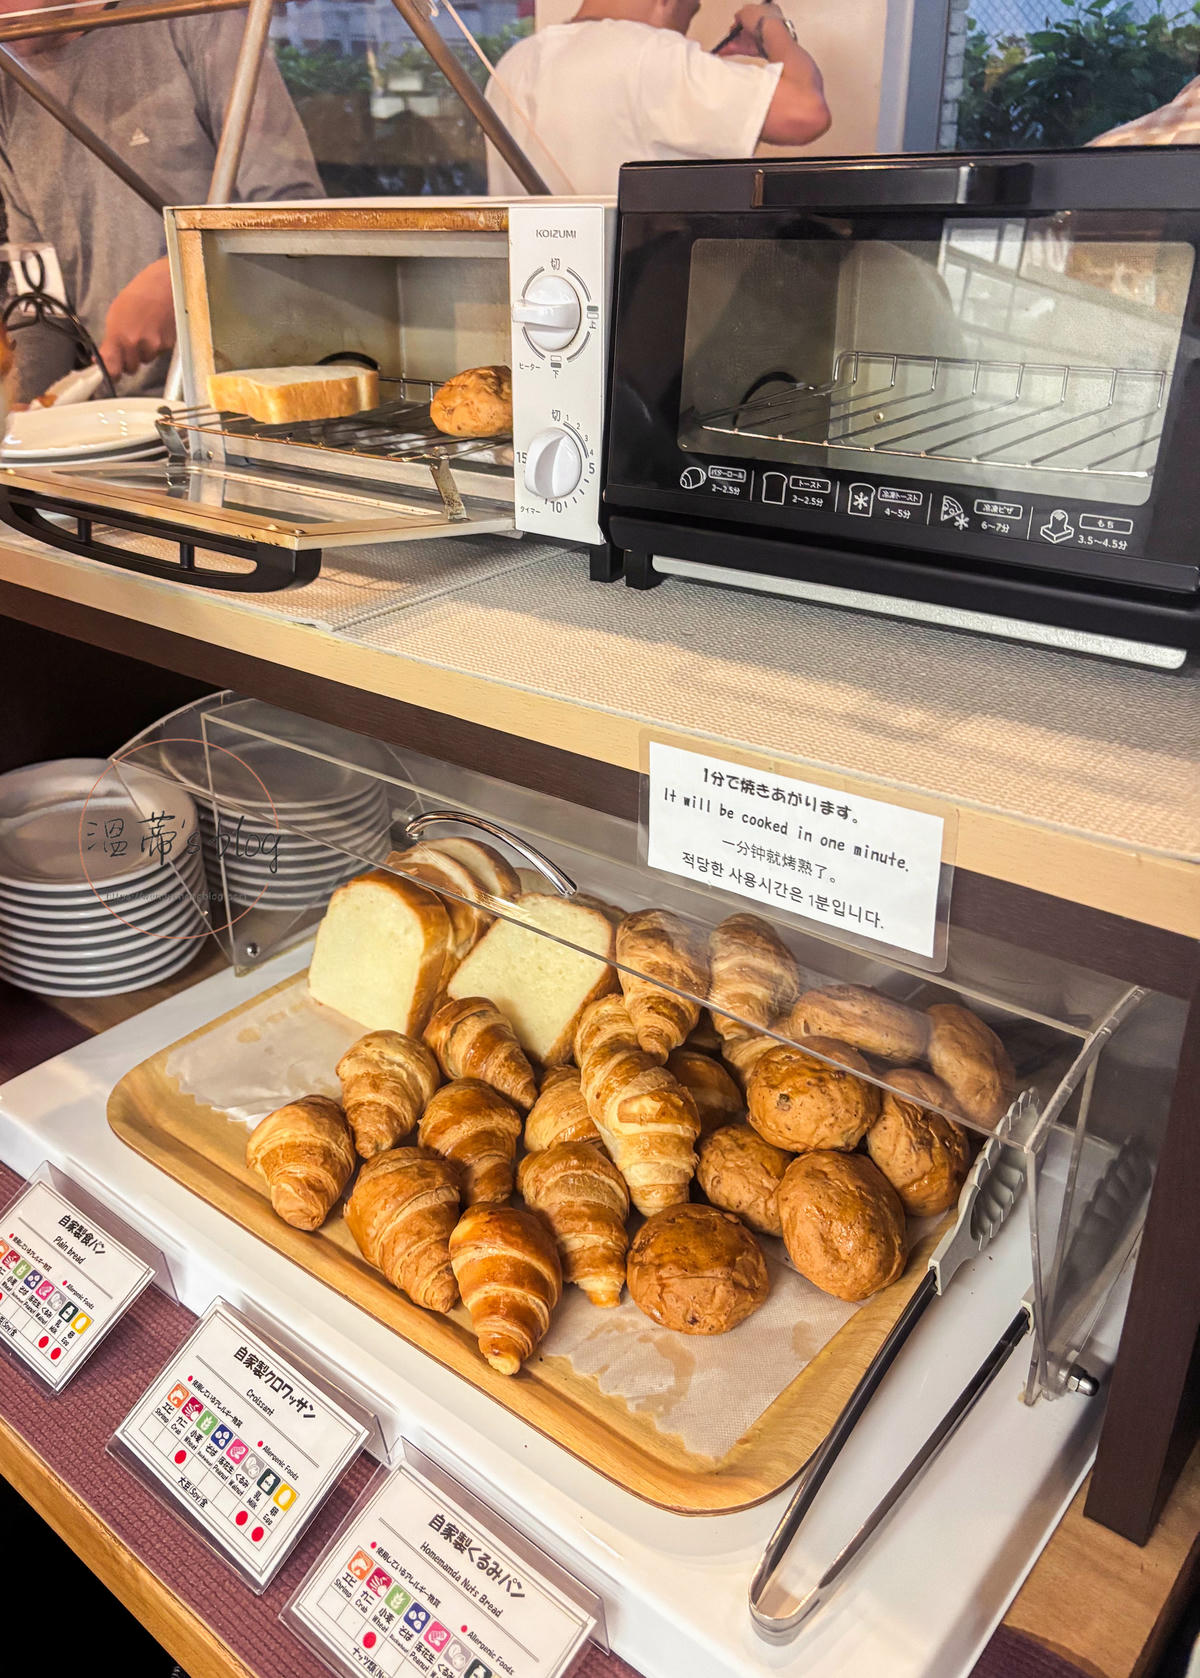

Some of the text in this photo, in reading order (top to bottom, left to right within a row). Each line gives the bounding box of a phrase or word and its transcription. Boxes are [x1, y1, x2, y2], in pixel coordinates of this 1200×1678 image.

[536, 229, 577, 240] KOIZUMI
[551, 258, 560, 270] 切
[519, 362, 541, 371] ヒーター
[552, 370, 560, 379] 下
[551, 410, 561, 422] 切
[576, 422, 581, 430] 2
[584, 434, 589, 442] 3
[516, 452, 528, 464] 15
[589, 448, 594, 456] 4
[588, 462, 595, 474] 5
[520, 506, 542, 514] タイマー
[551, 501, 562, 513] 10
[702, 766, 859, 825] 1分で焼きあがります。
[664, 787, 910, 872] It will be cooked in one minute.
[722, 838, 836, 884] 一分钟就烤熟了。
[682, 851, 884, 929] 적당한 사용시간은 1분입니다.
[58, 1214, 106, 1256] 自家製食パン
[53, 1235, 86, 1264] Plain bread
[233, 1346, 316, 1418] 自家製クロワッサン
[162, 1402, 175, 1415] エビ
[246, 1388, 275, 1416] Croissant
[262, 1445, 286, 1468] Allergenic
[212, 1464, 229, 1481] Peanut
[262, 1514, 273, 1526] Egg
[428, 1514, 525, 1598] 自家製くるみパン
[420, 1541, 504, 1618] Homemamda Nuts Bread
[334, 1578, 353, 1599] Shrimp
[354, 1598, 368, 1614] Crab
[371, 1614, 390, 1633] Wheat
[409, 1650, 430, 1672] Peanut
[342, 1572, 358, 1588] エビ
[360, 1590, 375, 1606] カニ
[378, 1608, 396, 1624] 小麦
[398, 1625, 414, 1642] そば
[414, 1640, 436, 1665] 落花生
[467, 1630, 515, 1676] Allergenic Foods
